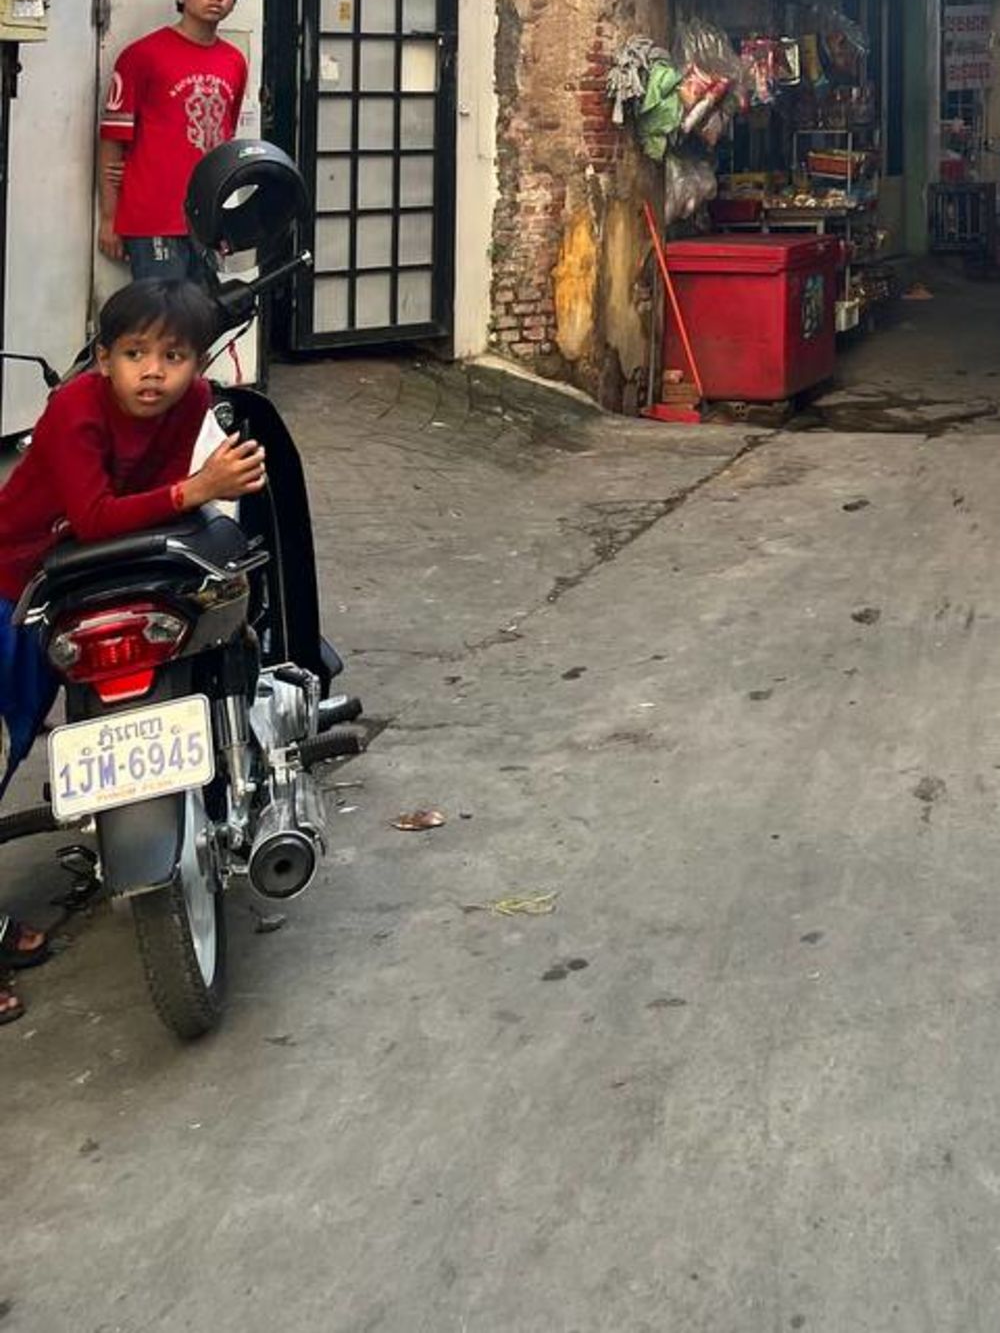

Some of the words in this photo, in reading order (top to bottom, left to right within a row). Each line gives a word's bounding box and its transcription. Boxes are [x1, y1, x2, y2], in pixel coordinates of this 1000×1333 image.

[97, 717, 164, 752] ភ្នំពេញ
[58, 731, 206, 800] 1JM-6945
